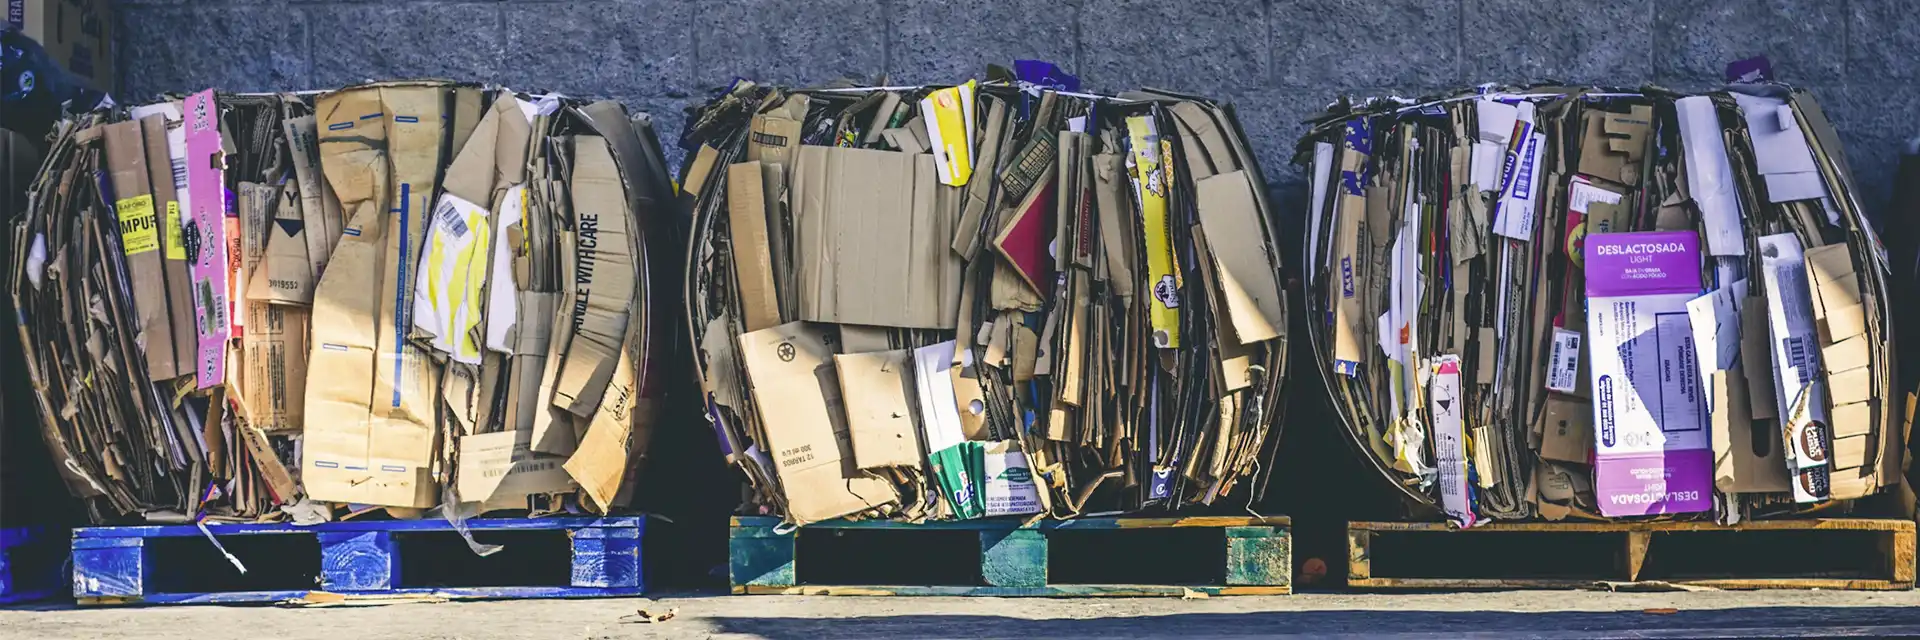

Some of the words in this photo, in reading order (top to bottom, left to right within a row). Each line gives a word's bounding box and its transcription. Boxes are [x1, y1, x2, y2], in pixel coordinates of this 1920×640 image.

[580, 213, 598, 249] CARE
[1597, 243, 1686, 255] DESLACTOSADA
[575, 249, 596, 284] WITH
[1630, 255, 1653, 264] LIGHT
[1611, 490, 1699, 505] DESLACTOSADA
